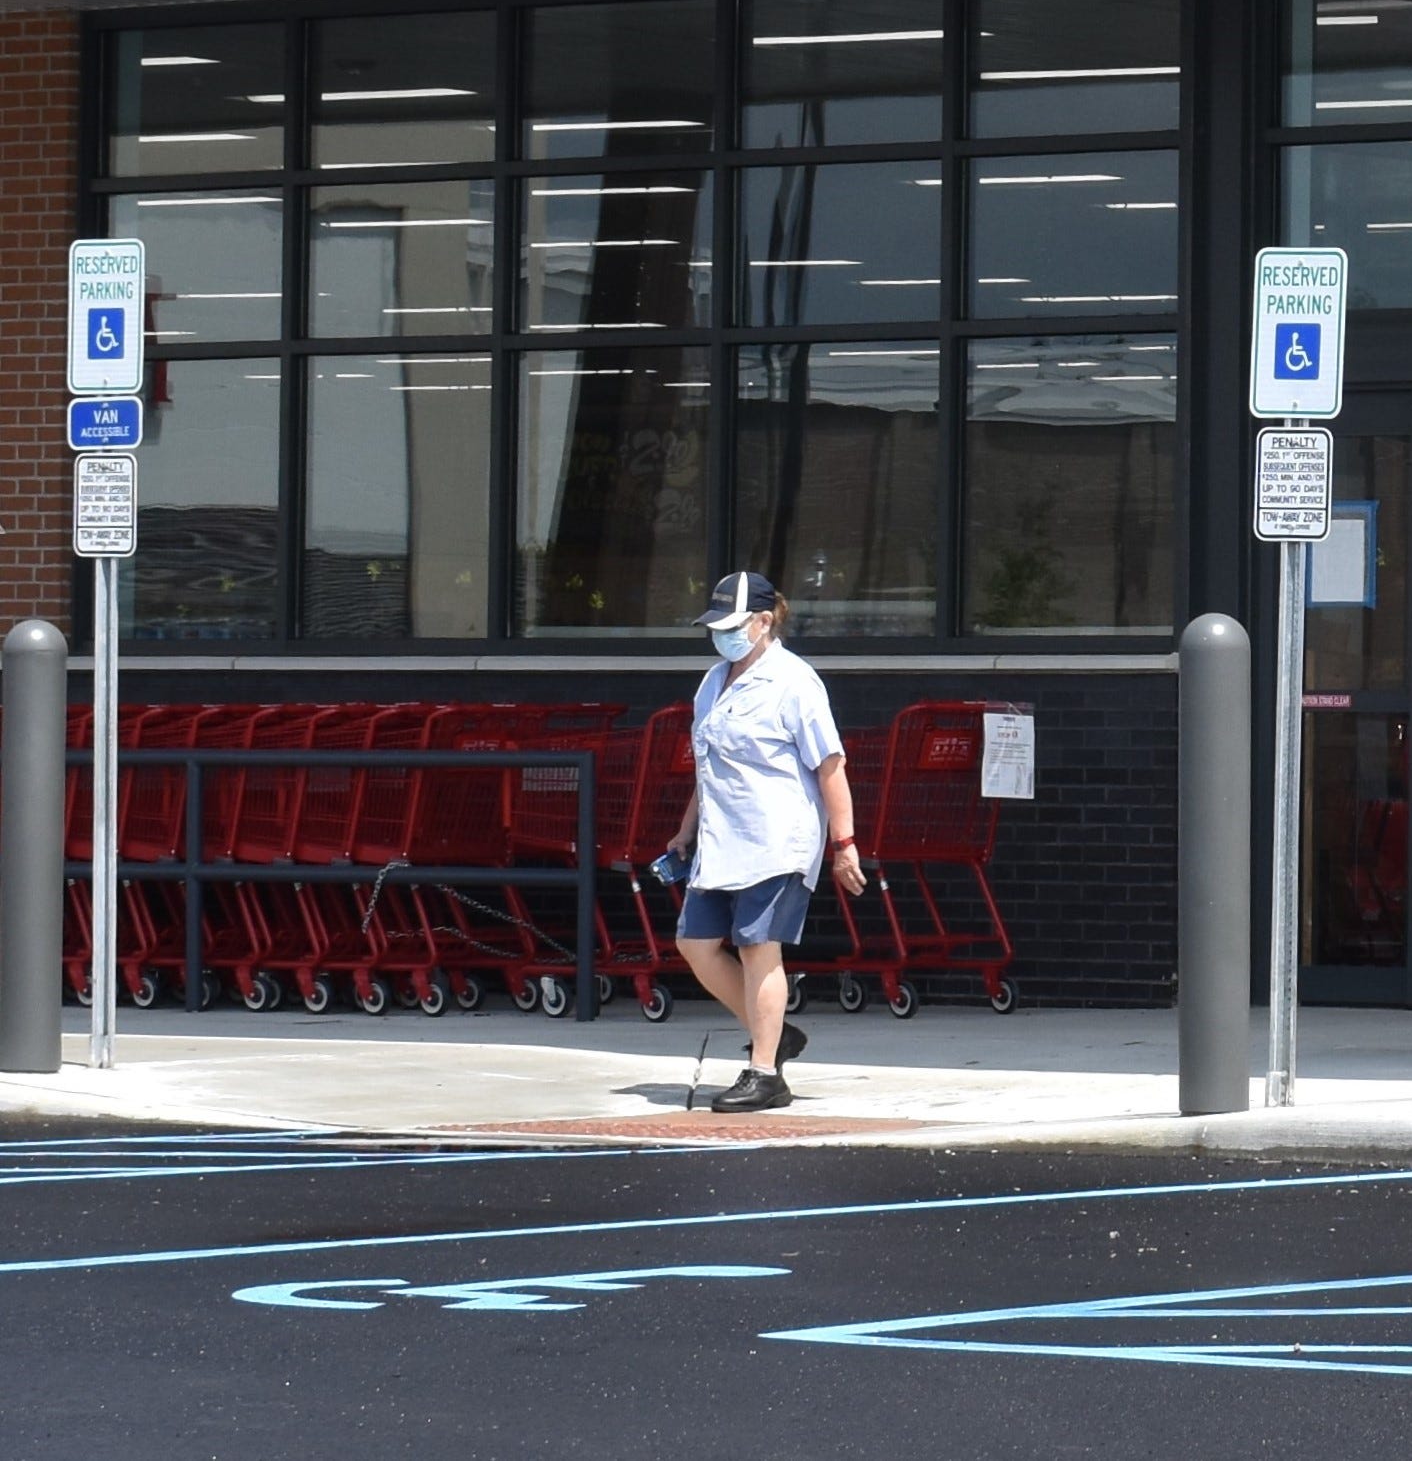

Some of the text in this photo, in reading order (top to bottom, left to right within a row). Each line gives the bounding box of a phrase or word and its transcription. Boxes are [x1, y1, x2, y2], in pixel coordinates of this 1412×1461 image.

[76, 255, 138, 274] RESERVED
[1263, 266, 1338, 287] RESERVED
[80, 281, 134, 299] PARKING
[1267, 295, 1332, 315] PARKING
[93, 409, 119, 424] VAN
[81, 426, 130, 437] ACCESSIBLE
[1277, 484, 1287, 492] TO
[1304, 484, 1324, 493] DAYS
[1262, 512, 1323, 523] TOW-AWAY ZONE
